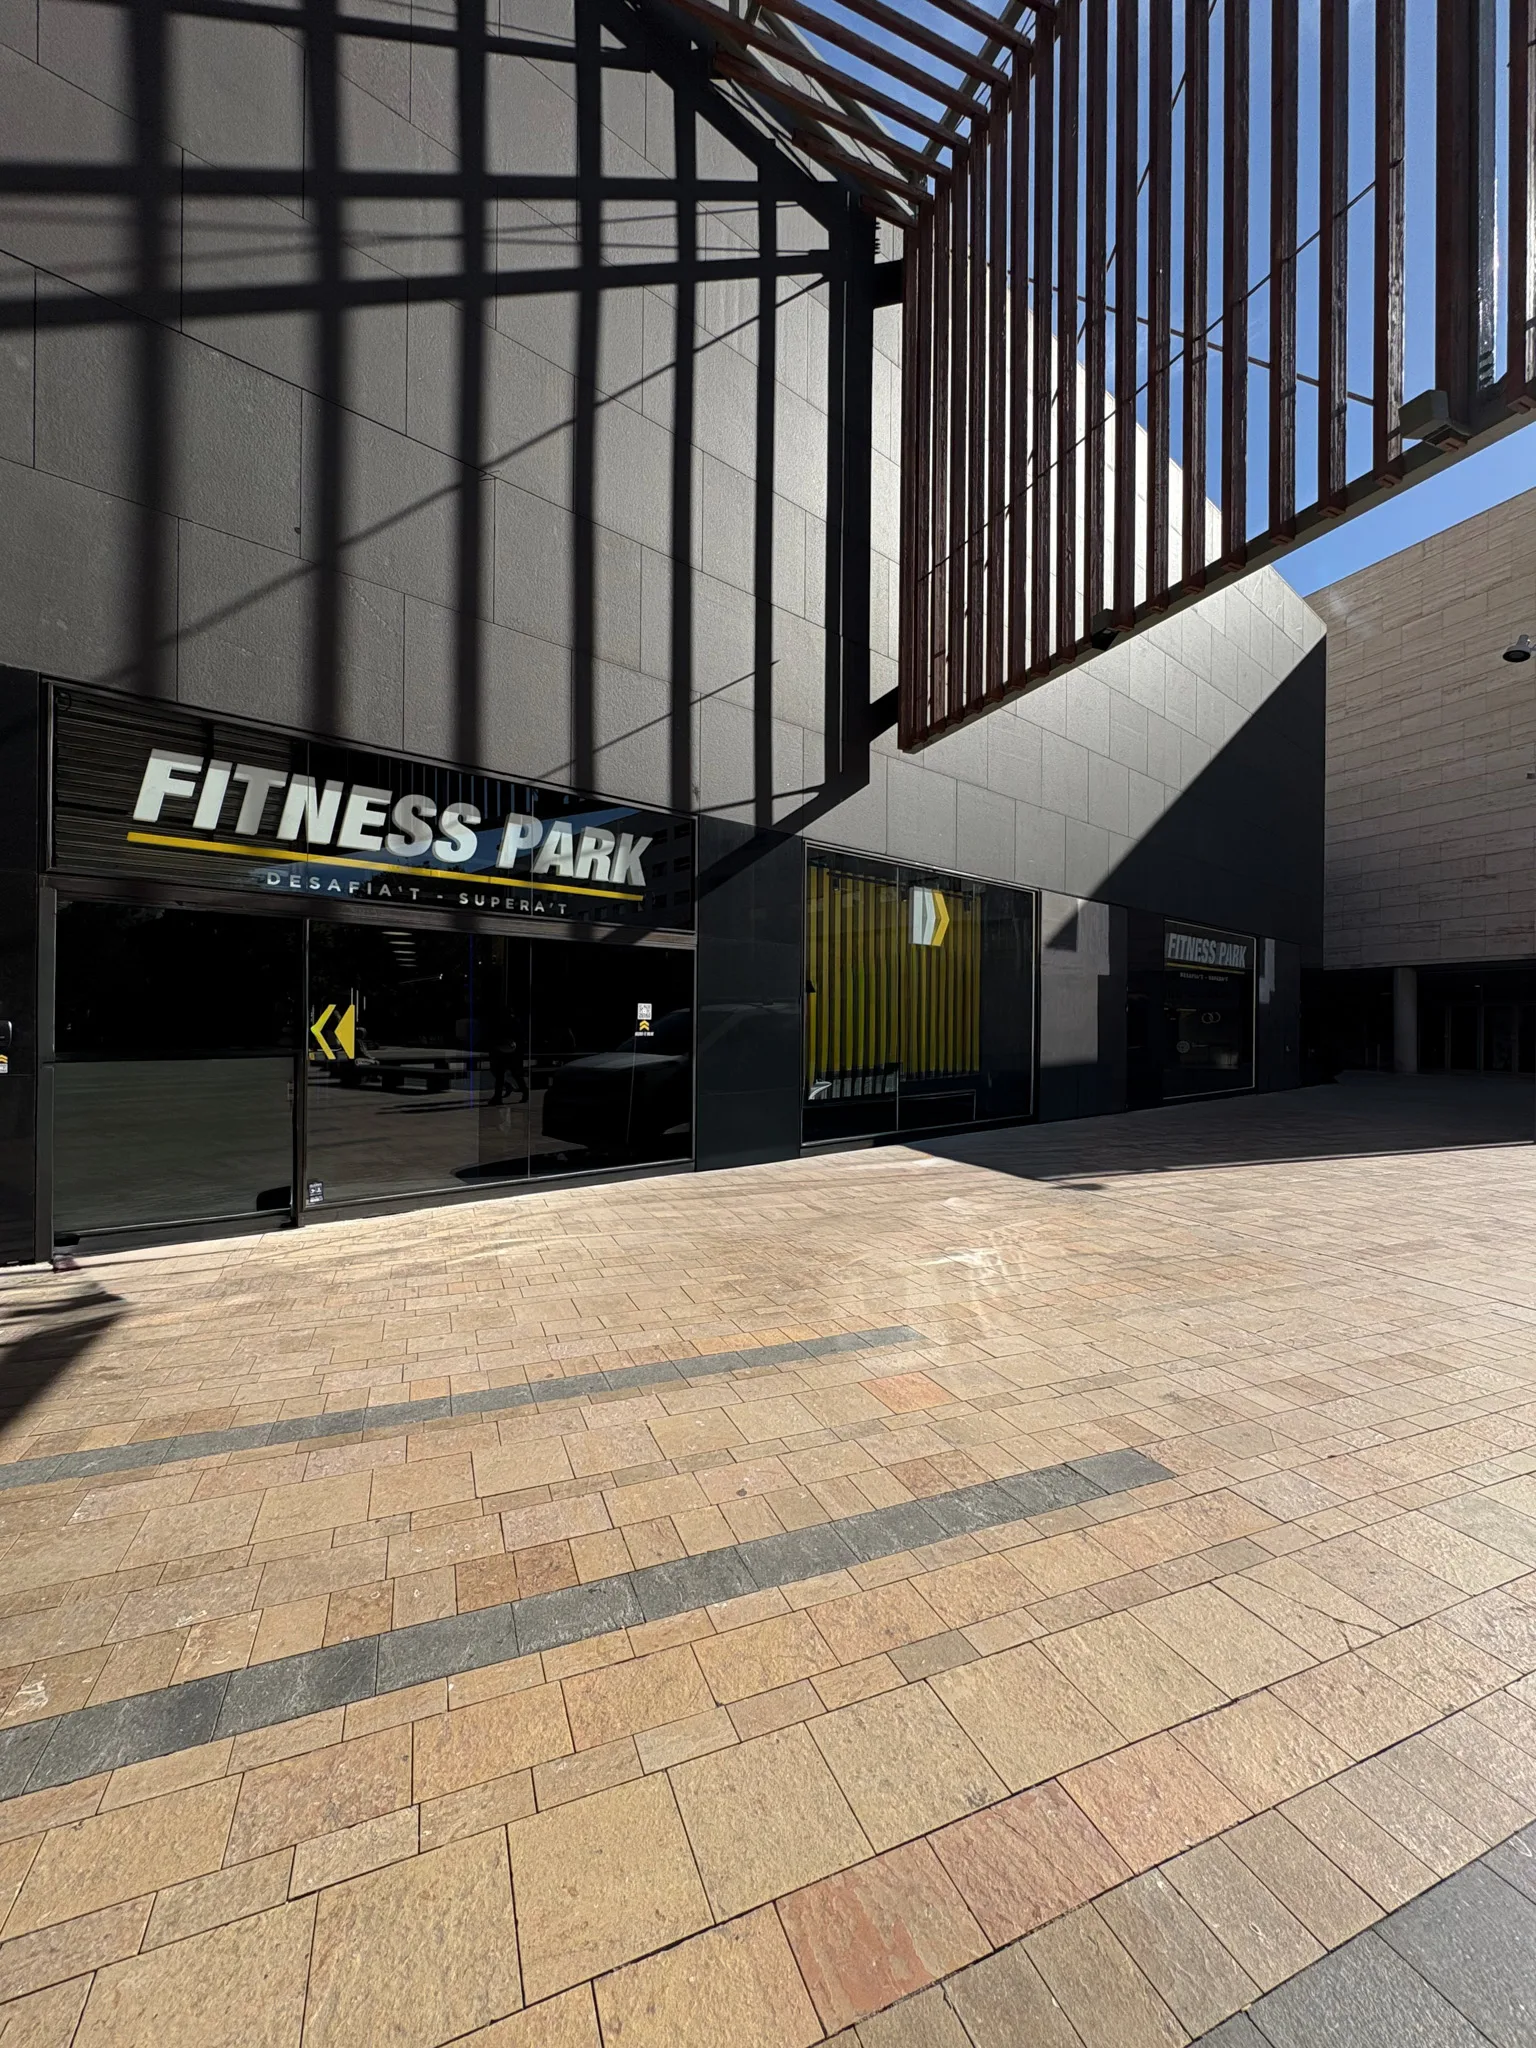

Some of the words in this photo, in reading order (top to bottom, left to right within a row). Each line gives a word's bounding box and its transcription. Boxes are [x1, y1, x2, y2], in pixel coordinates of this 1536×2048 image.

[133, 748, 482, 863] FITNESS
[496, 812, 654, 887] PARK
[266, 871, 420, 900] DESAFIA'T
[459, 892, 568, 914] SUPERA'T
[1167, 932, 1217, 964] FITNESS
[1219, 941, 1247, 968] PARK
